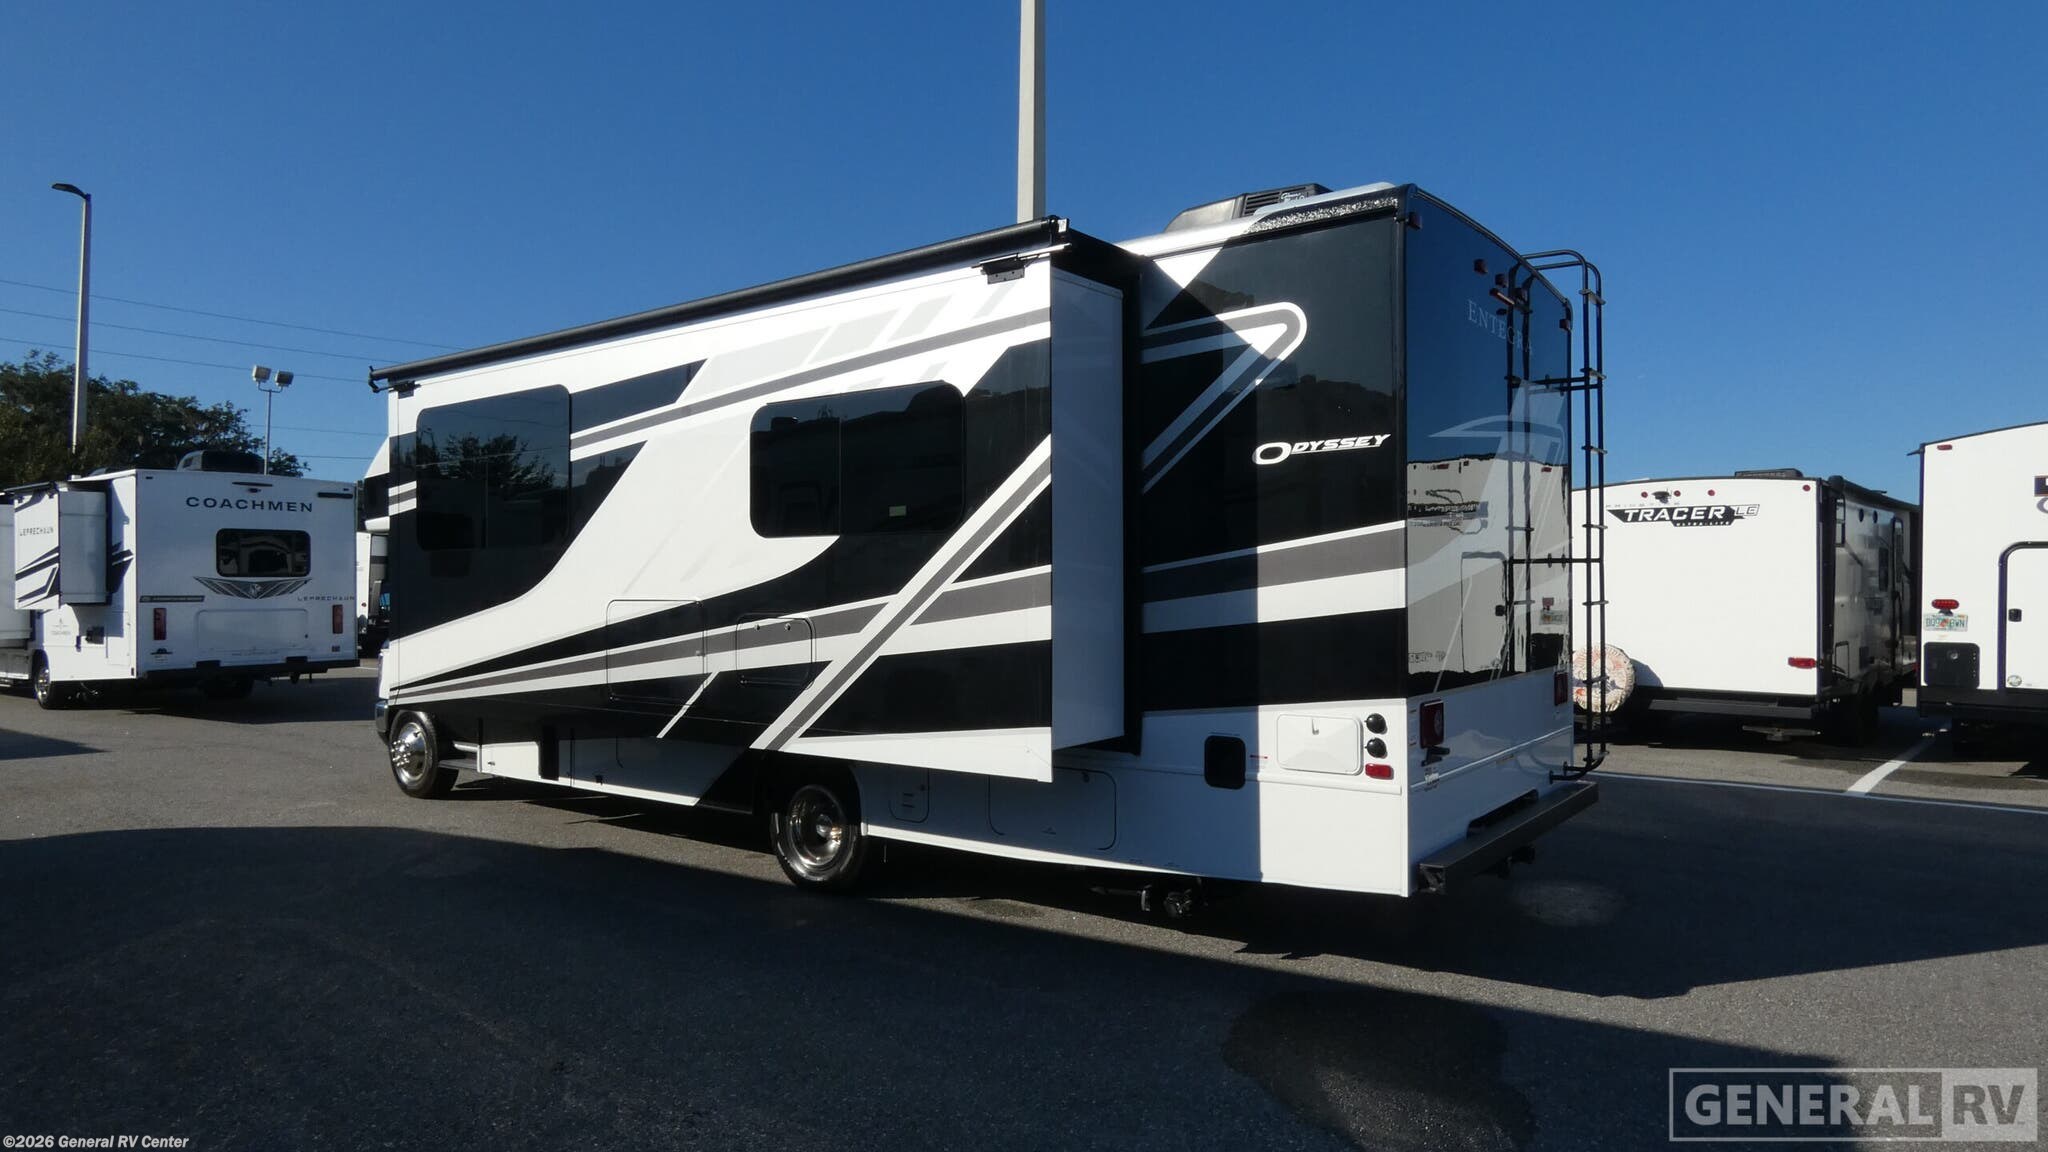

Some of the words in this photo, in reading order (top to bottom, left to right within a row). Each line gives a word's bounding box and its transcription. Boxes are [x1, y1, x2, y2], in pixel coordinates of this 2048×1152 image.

[1252, 434, 1391, 465] ODYSSEY
[186, 496, 313, 513] COACHMEN
[1623, 506, 1726, 521] TRACER
